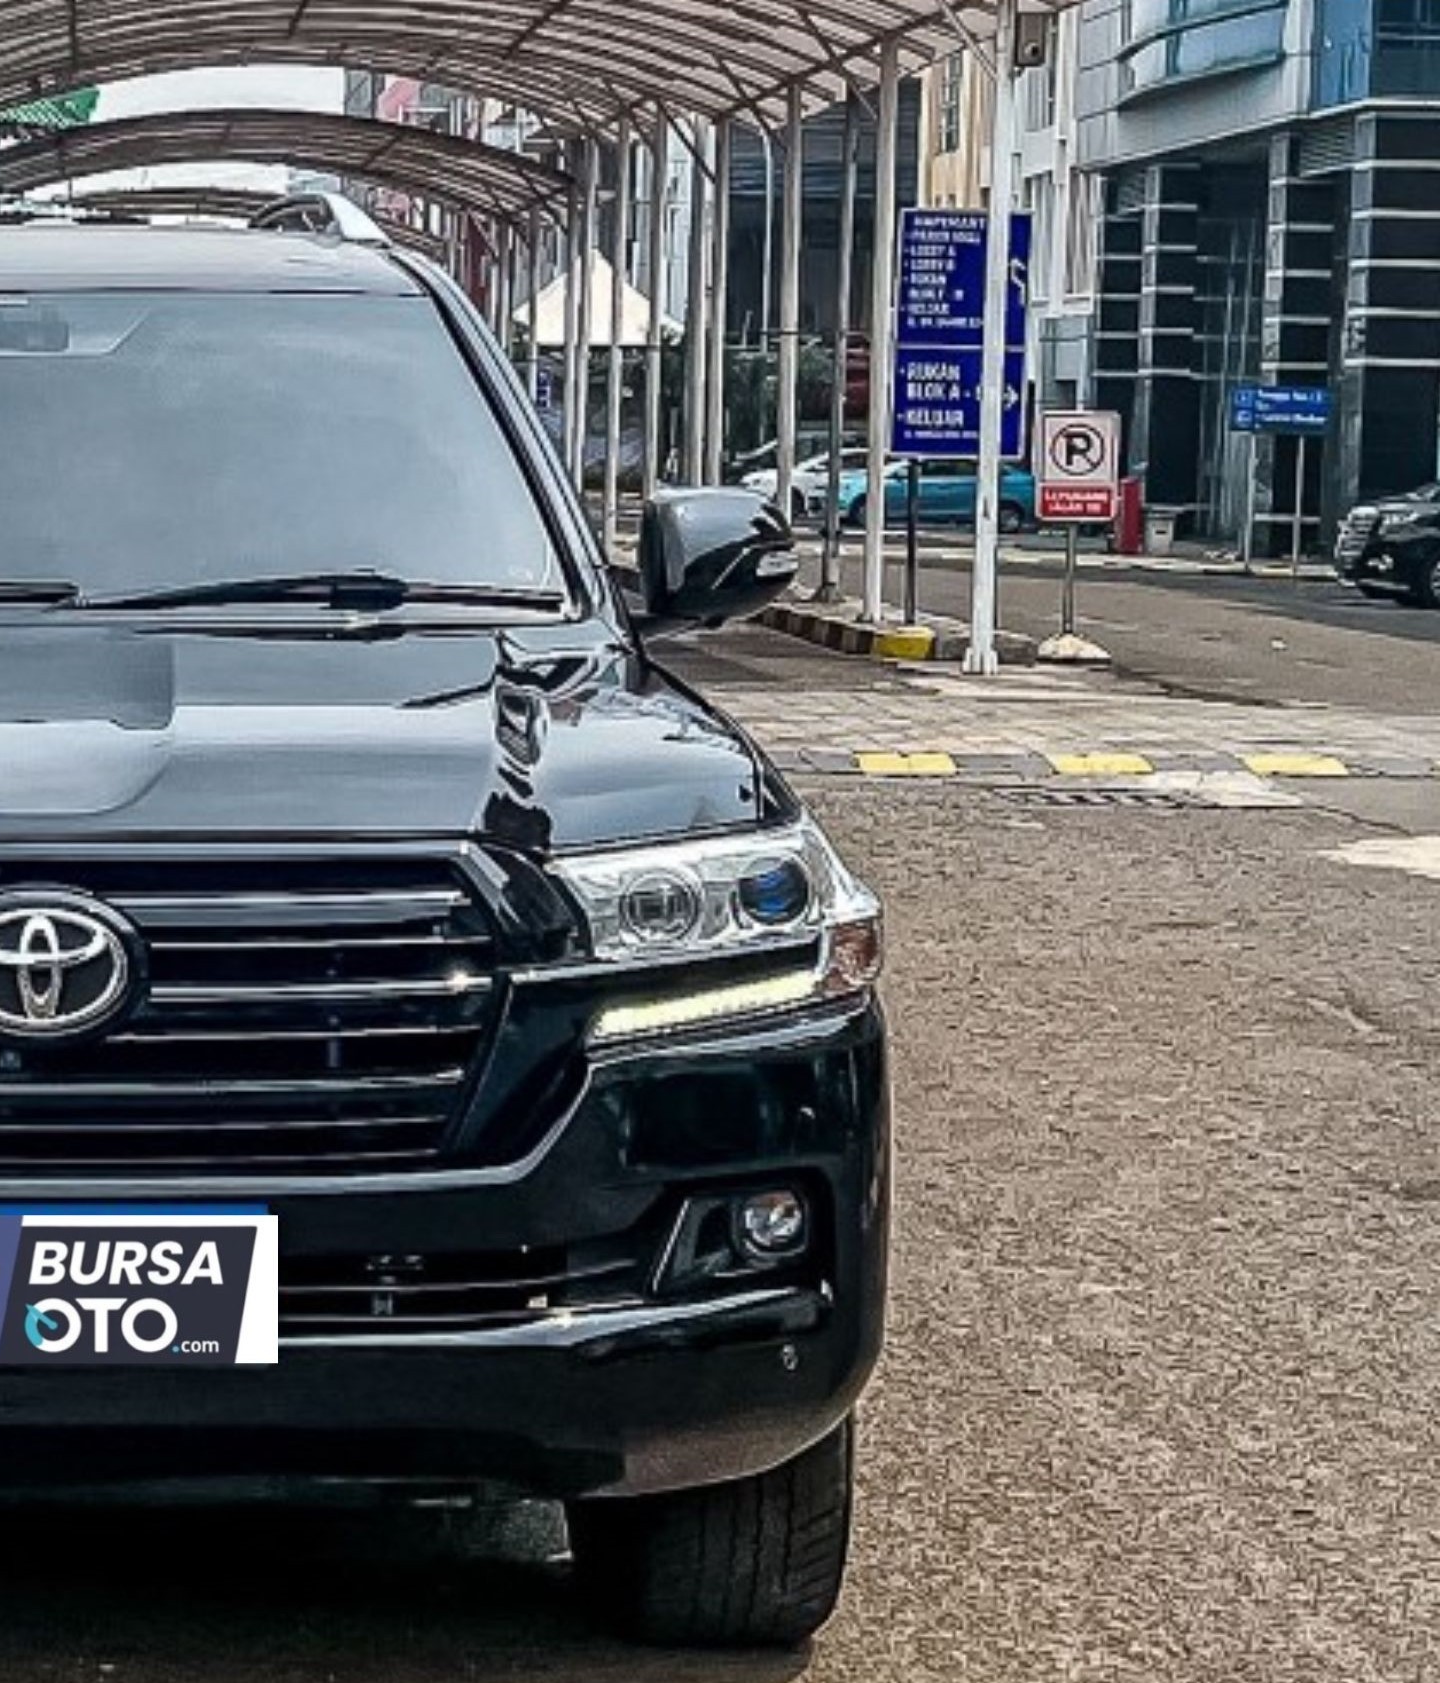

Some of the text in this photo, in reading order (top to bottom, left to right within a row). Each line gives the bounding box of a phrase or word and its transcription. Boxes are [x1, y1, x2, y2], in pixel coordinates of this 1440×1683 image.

[906, 362, 960, 380] RUKAN
[906, 382, 946, 400] BLOK
[948, 383, 960, 400] A
